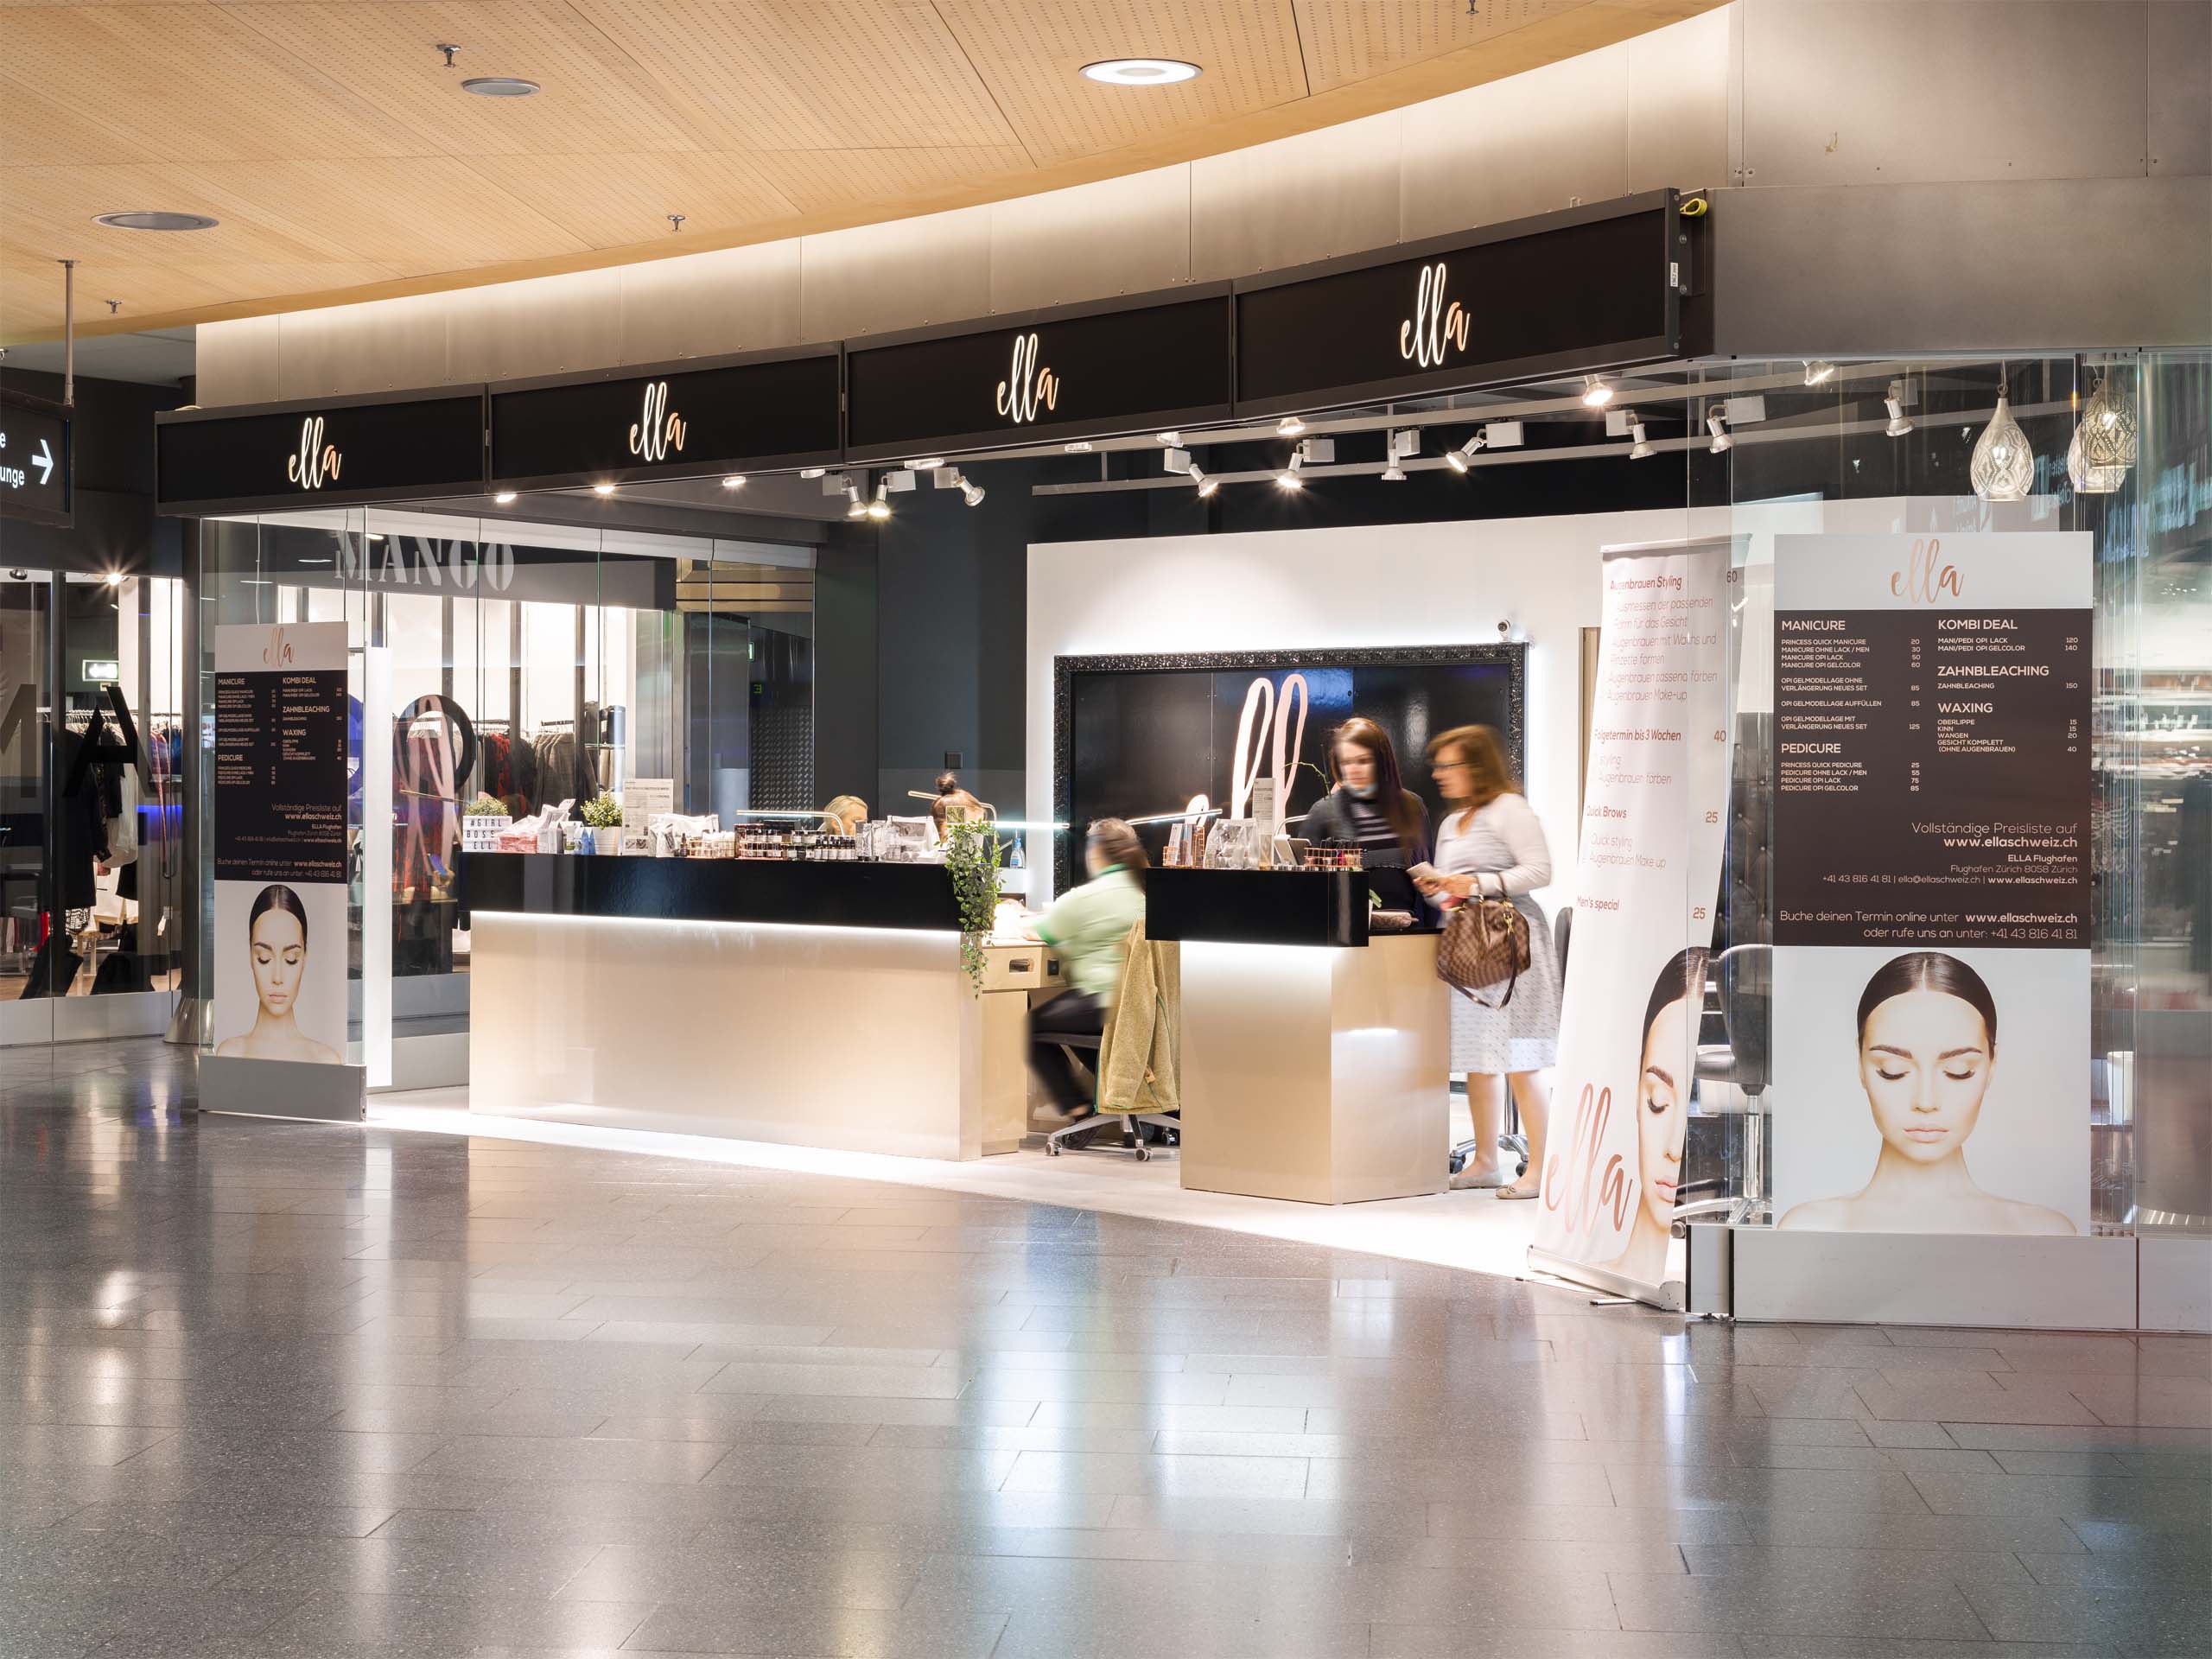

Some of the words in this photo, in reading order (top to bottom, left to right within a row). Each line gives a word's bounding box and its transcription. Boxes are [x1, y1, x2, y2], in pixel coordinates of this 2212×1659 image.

[1401, 263, 1470, 367] ella
[997, 333, 1059, 423] ella
[629, 382, 686, 461] ella
[289, 416, 341, 489] ella
[334, 530, 515, 591] MANGO
[1891, 538, 1964, 603] ella
[1656, 575, 1681, 590] Styling
[1726, 571, 1738, 582] 60
[1782, 620, 1846, 630] MANICURE
[1938, 620, 1980, 629] KOMBI
[1984, 620, 2018, 629] DEAL
[263, 627, 295, 668] ella
[1938, 666, 2049, 676] ZAHNBLEACHING
[1938, 703, 1993, 713] WAXING
[1635, 729, 1644, 741] bis
[1645, 729, 1649, 741] 3
[1651, 729, 1681, 741] Wochen
[1714, 730, 1726, 742] 40
[1782, 744, 1840, 753] PEDICURE
[1603, 806, 1627, 818] Brows
[1706, 811, 1719, 823] 25
[1912, 823, 1989, 837] Vollständige
[1994, 823, 2052, 834] Preisliste
[2056, 823, 2077, 834] auf
[1944, 836, 2077, 847] www.ellaschweiz.ch
[2033, 855, 2077, 864] Flughafen
[1951, 865, 1993, 875] Flughafen
[1871, 874, 1879, 883] 41
[1882, 874, 1891, 883] 81
[1898, 875, 1980, 884] ella@ellaschweiz.ch
[1594, 899, 1619, 912] special
[1693, 907, 1706, 919] 25
[1780, 911, 1813, 920] Buche
[1816, 911, 1852, 921] deinen
[1855, 912, 1892, 921] Termin
[1896, 912, 1927, 922] online
[1929, 913, 1959, 922] unter
[1966, 913, 2077, 923] www.ellaschweiz.ch
[1864, 928, 1889, 938] oder
[1892, 927, 1914, 938] rufe
[1956, 929, 1987, 938] unter:
[1991, 929, 2007, 938] +41
[2011, 929, 2025, 938] 43
[2029, 929, 2048, 938] 816
[2051, 929, 2063, 938] 41
[2066, 929, 2077, 938] 81
[1545, 1083, 1633, 1236] ella
